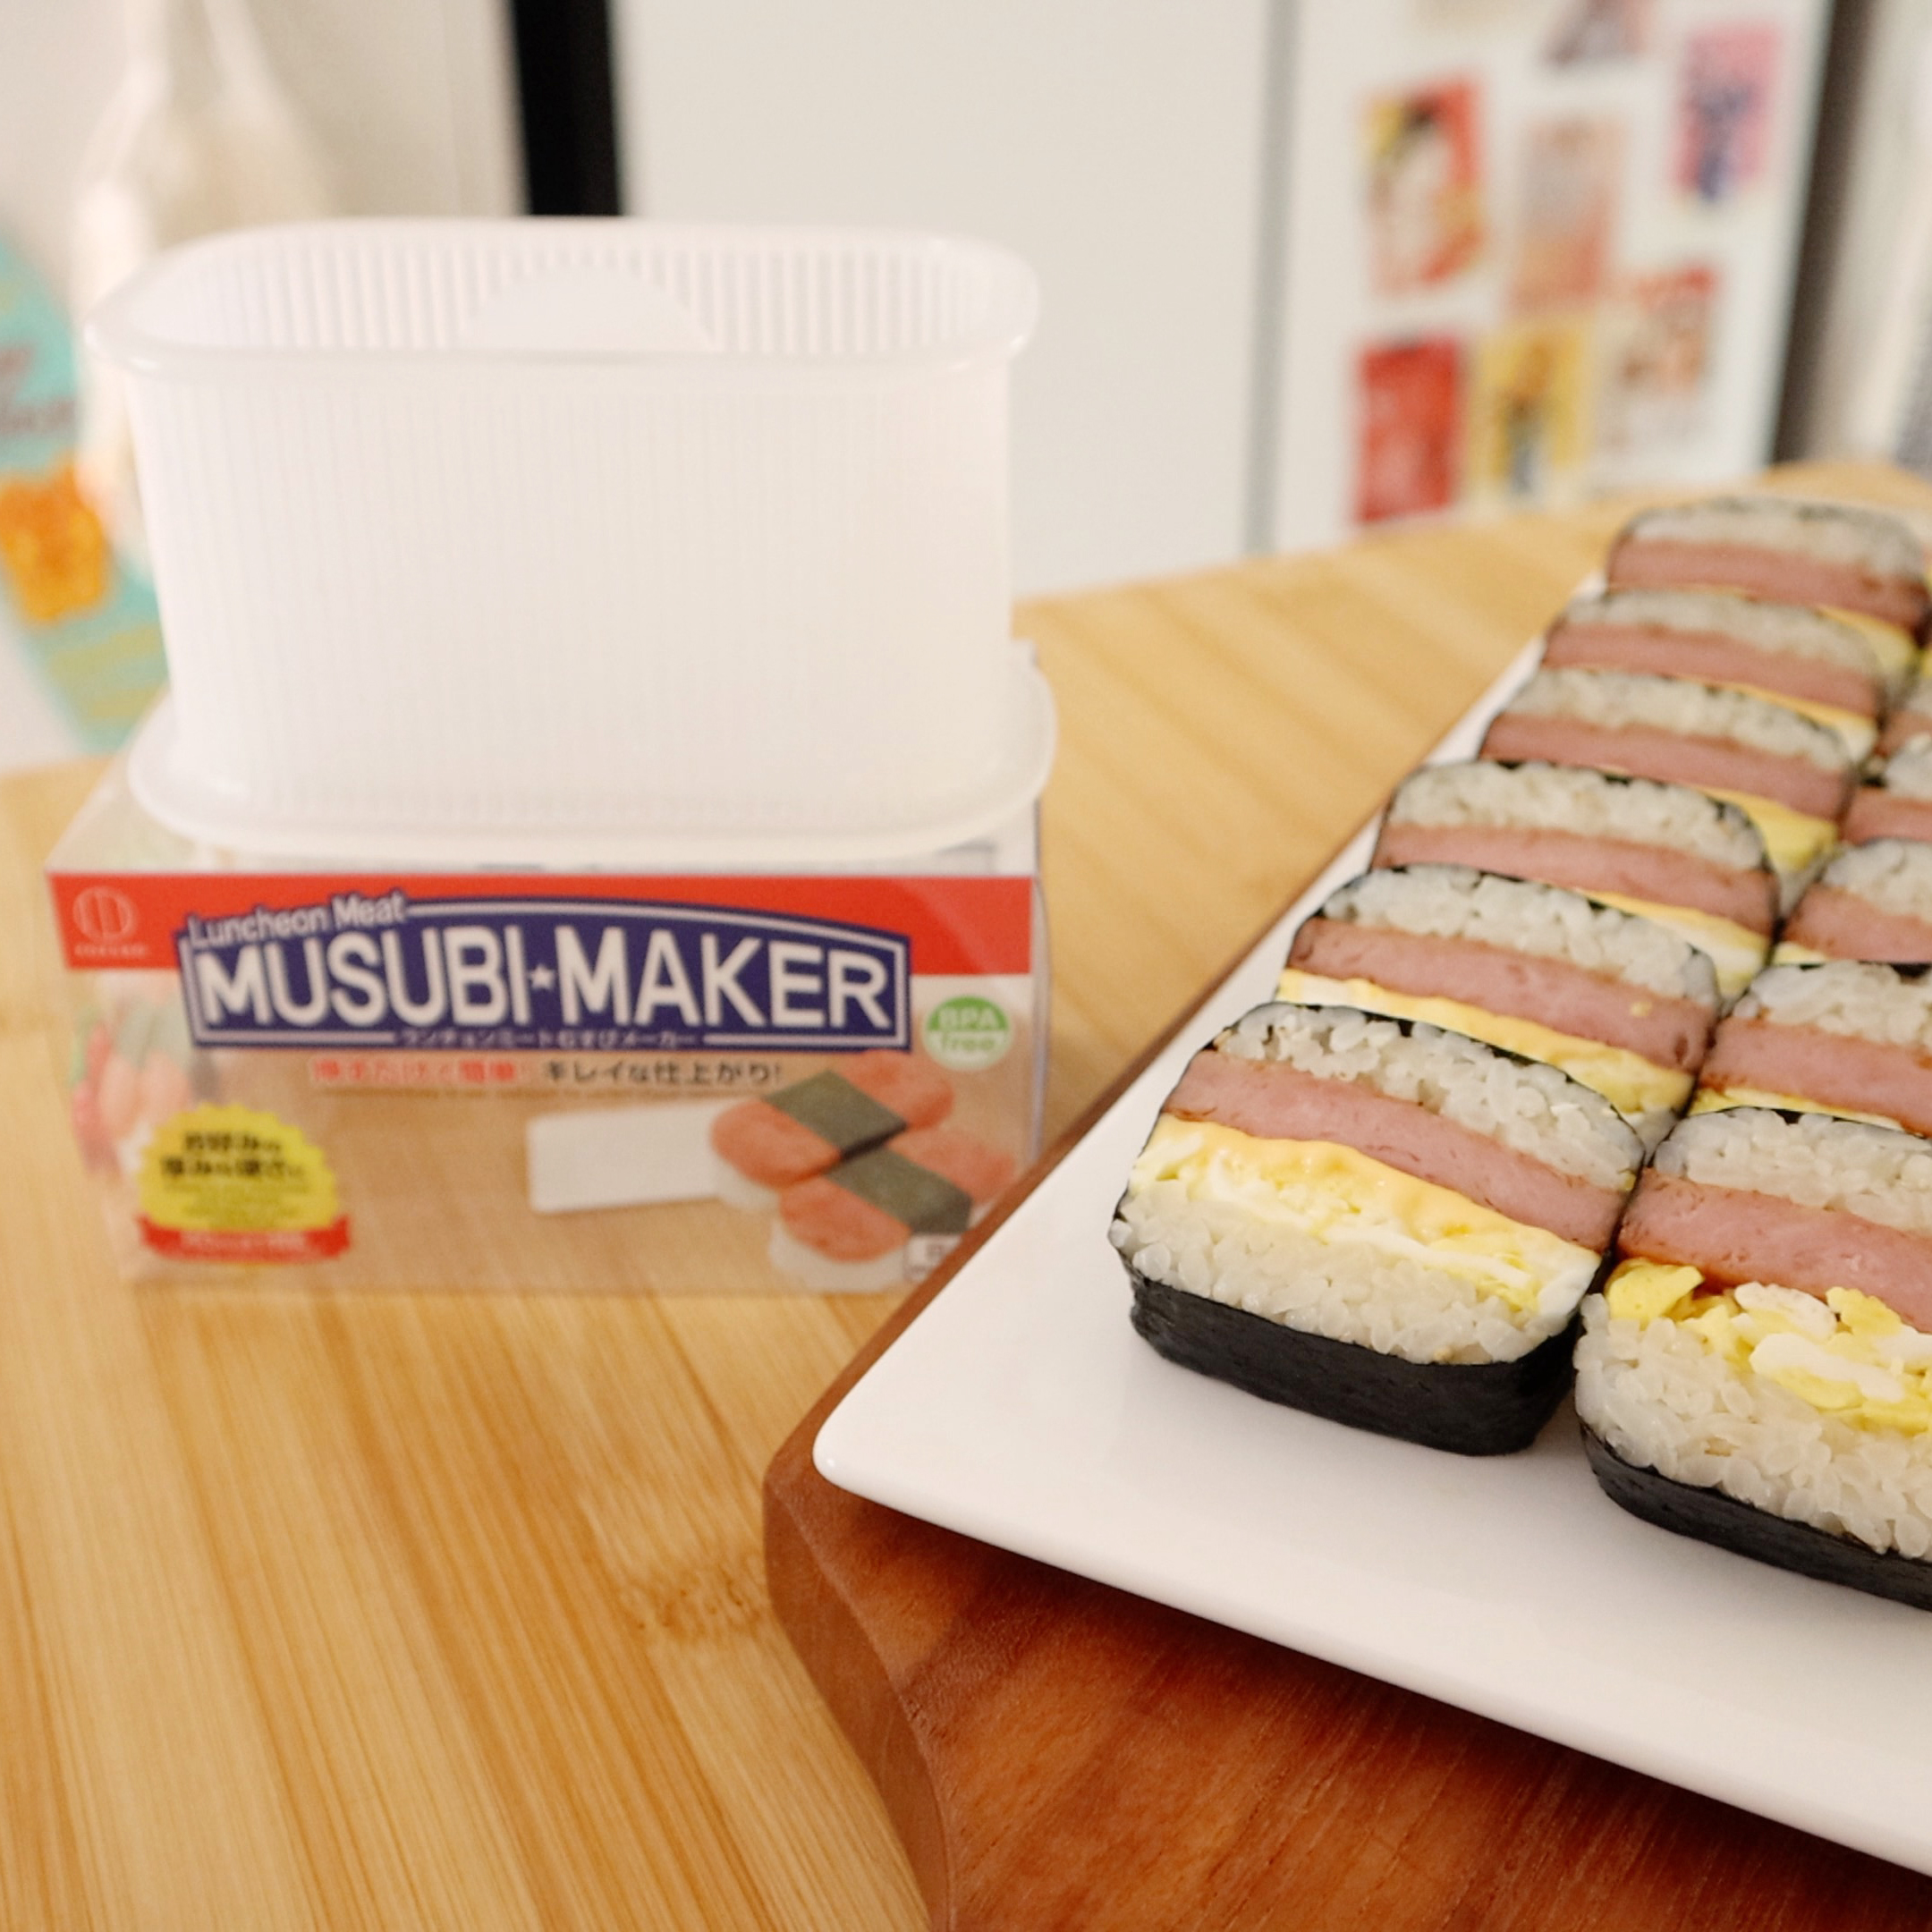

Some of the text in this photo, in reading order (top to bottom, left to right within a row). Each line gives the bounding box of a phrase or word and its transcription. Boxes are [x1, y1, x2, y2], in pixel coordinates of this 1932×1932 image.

[187, 890, 406, 950] Luncheon Meat
[195, 924, 893, 1029] MUSUBI MAKER
